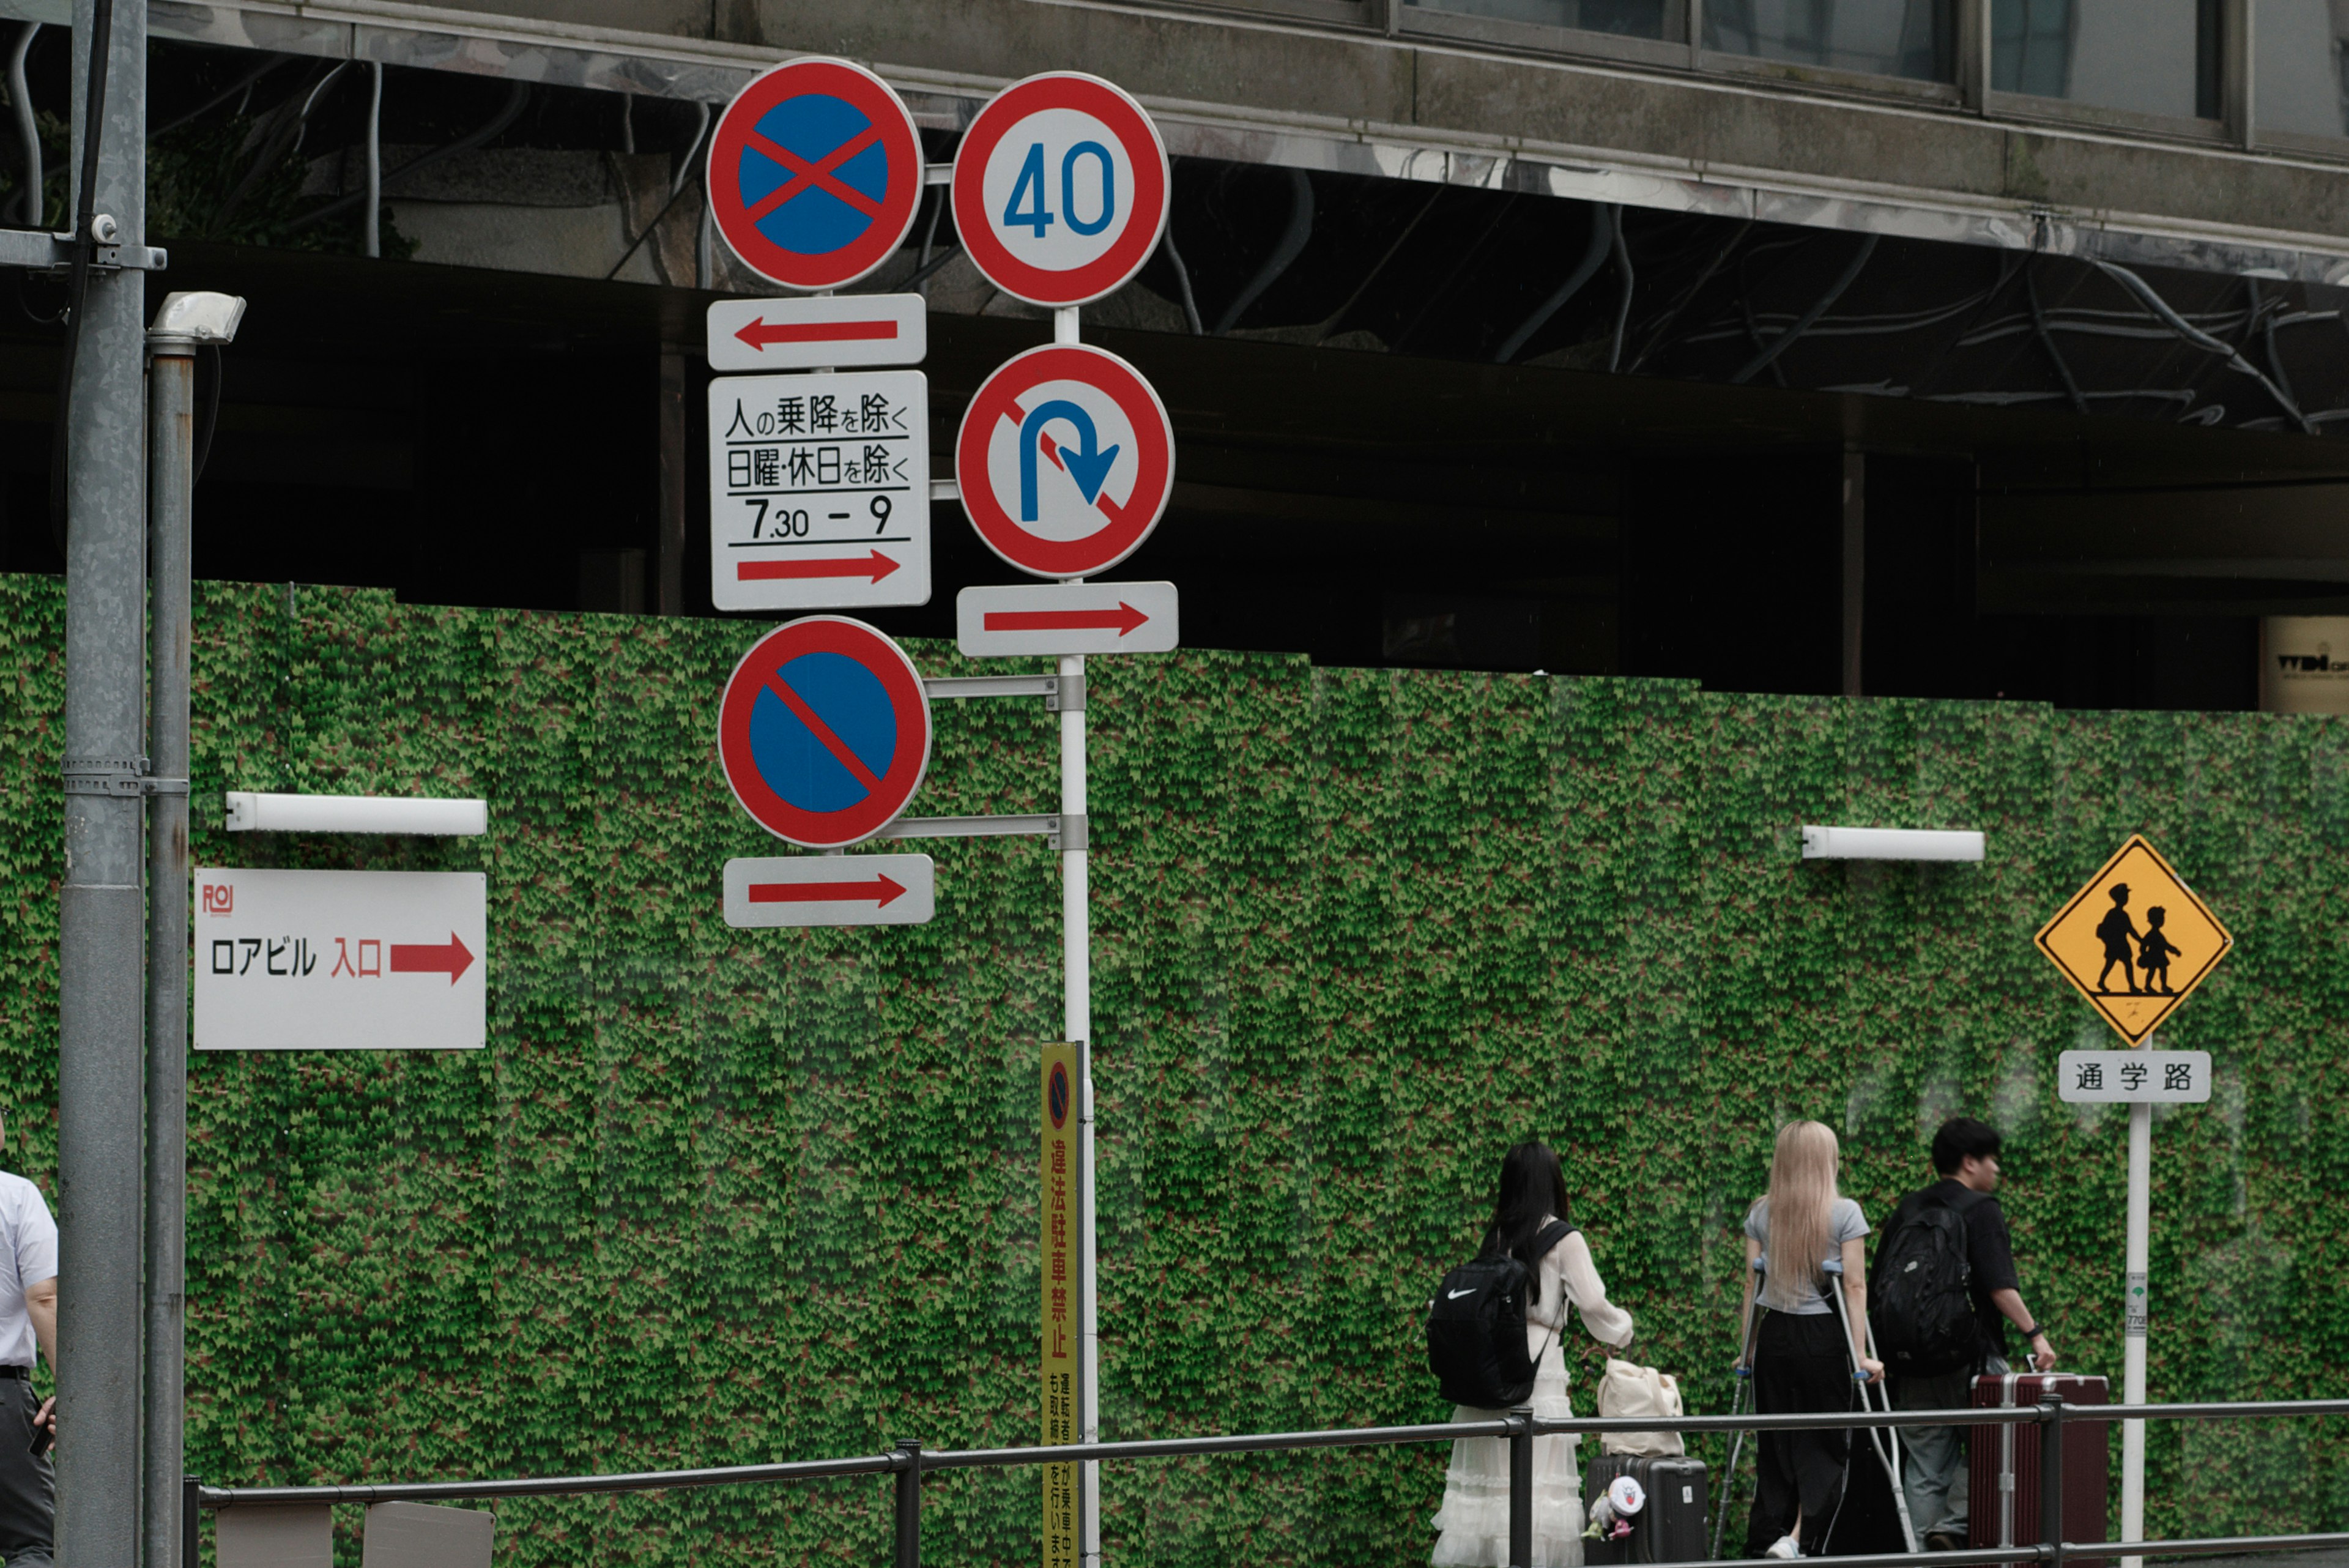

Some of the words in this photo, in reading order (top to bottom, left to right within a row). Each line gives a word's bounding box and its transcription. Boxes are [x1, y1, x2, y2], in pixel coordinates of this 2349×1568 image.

[1003, 140, 1115, 238] 40
[725, 393, 908, 437] 人の乗降を除く
[745, 499, 809, 538] 7.30
[870, 495, 892, 535] 9
[212, 935, 317, 977] ロアビル
[331, 937, 381, 978] 入口
[2076, 1062, 2191, 1091] 通学路
[1051, 1139, 1067, 1359] 違法駐車禁止
